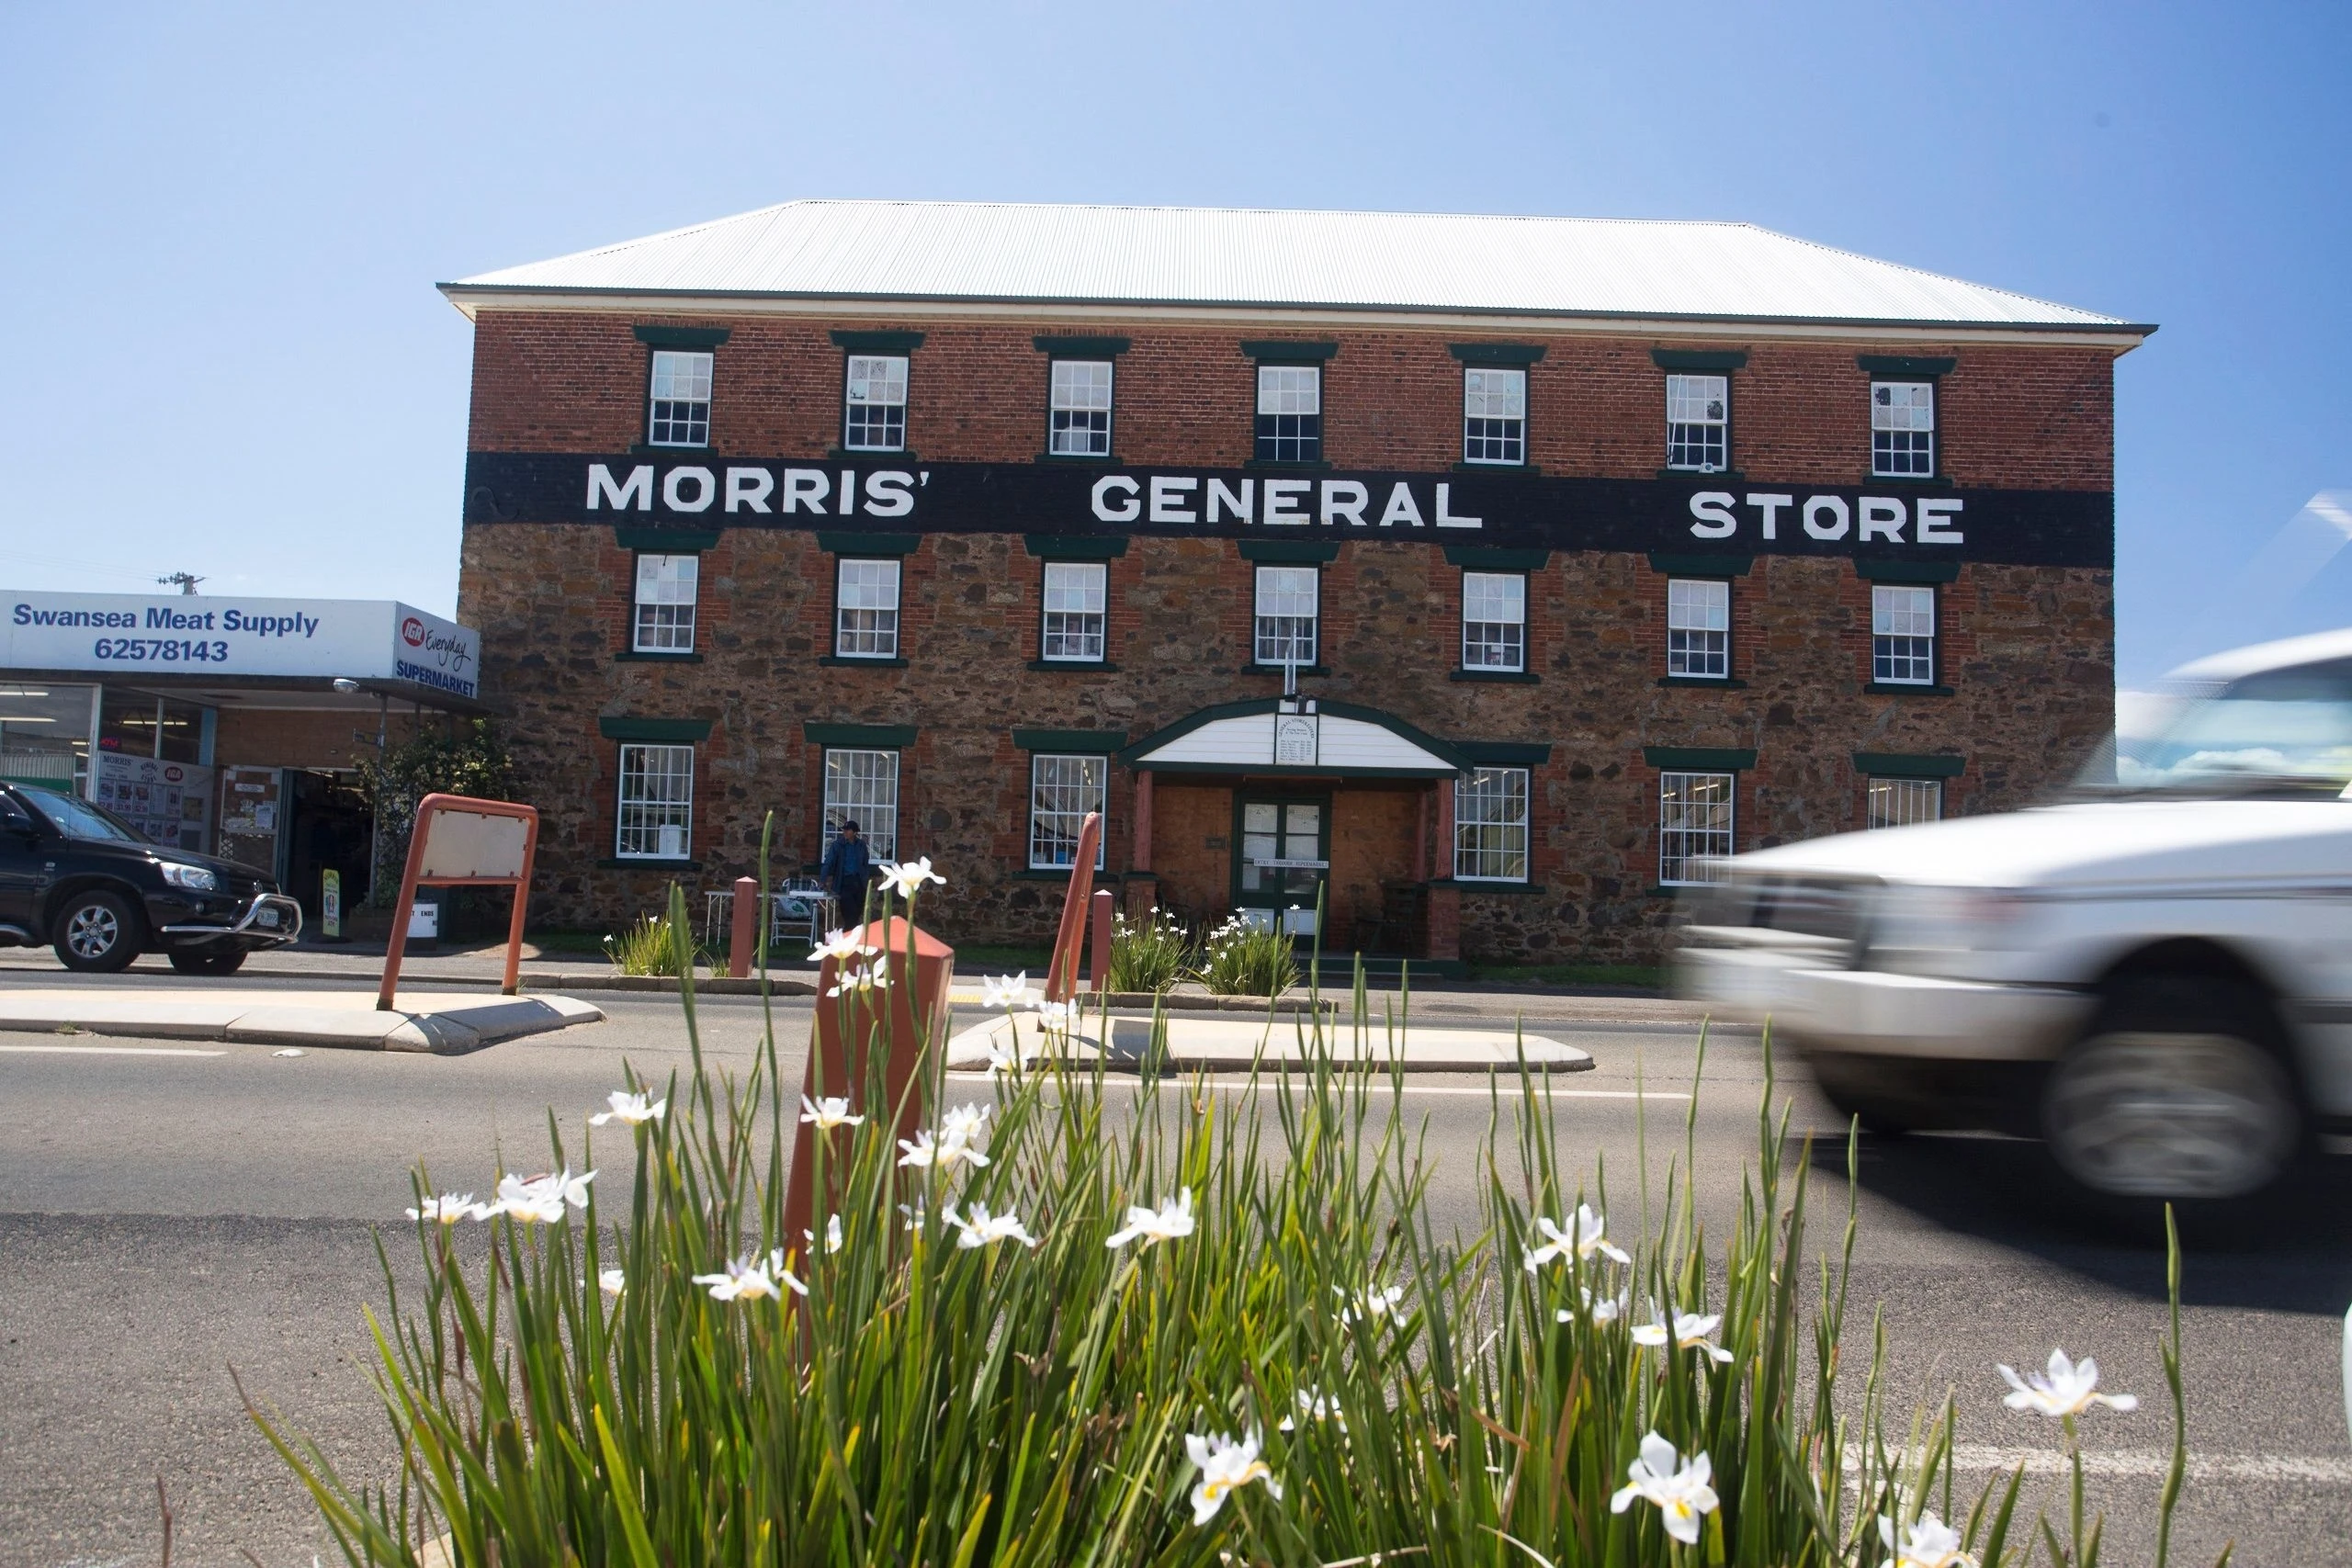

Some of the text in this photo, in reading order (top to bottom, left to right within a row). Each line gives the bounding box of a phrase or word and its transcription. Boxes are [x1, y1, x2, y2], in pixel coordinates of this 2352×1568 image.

[586, 463, 1964, 544] MORRIS' GENERAL STORE
[13, 604, 320, 638] Swansea Meat Supply
[95, 637, 229, 662] 62578143
[404, 621, 472, 672] IGA Everyday
[396, 660, 475, 697] SUPERMARKET
[166, 768, 181, 780] IGA
